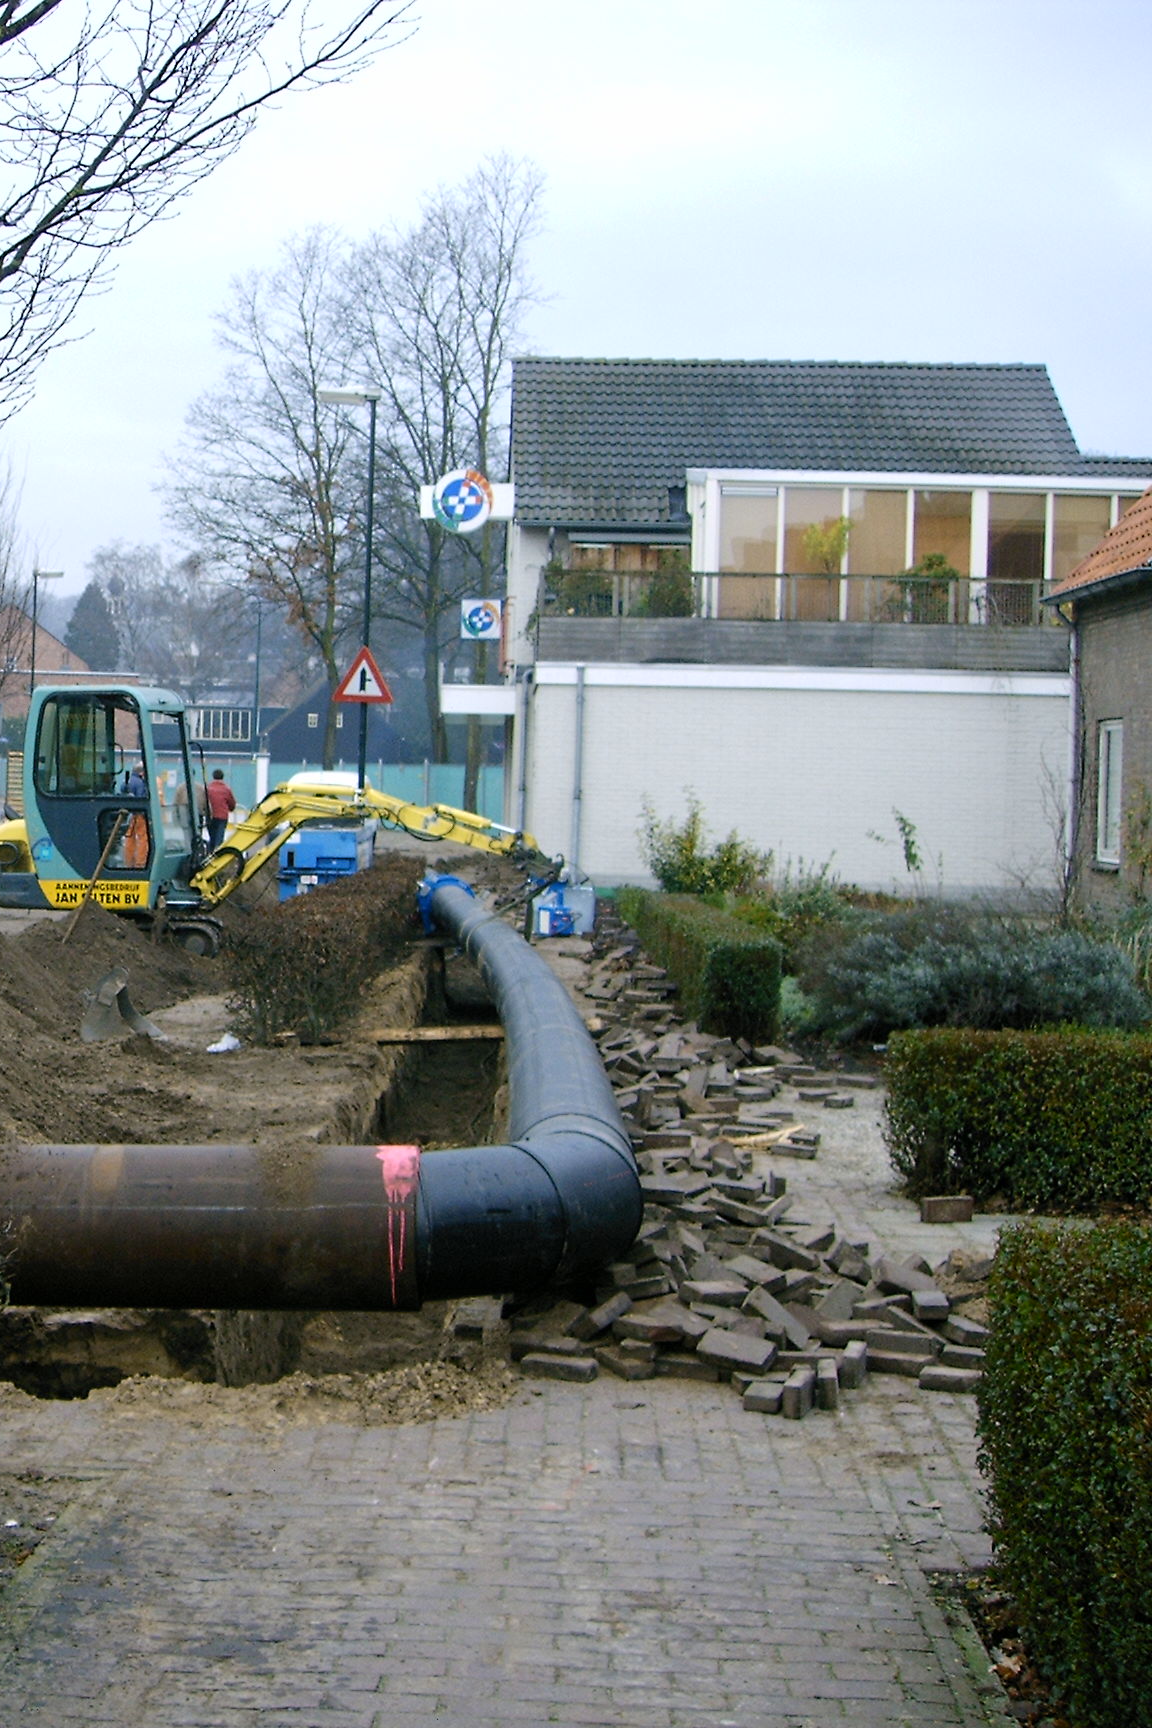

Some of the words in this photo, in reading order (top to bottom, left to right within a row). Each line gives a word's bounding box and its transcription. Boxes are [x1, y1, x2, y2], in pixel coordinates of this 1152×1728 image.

[56, 883, 140, 891] AANNEMNGSBEDRIJF
[55, 892, 78, 903] JAN
[81, 892, 122, 904] LTEN
[124, 893, 140, 904] BV
